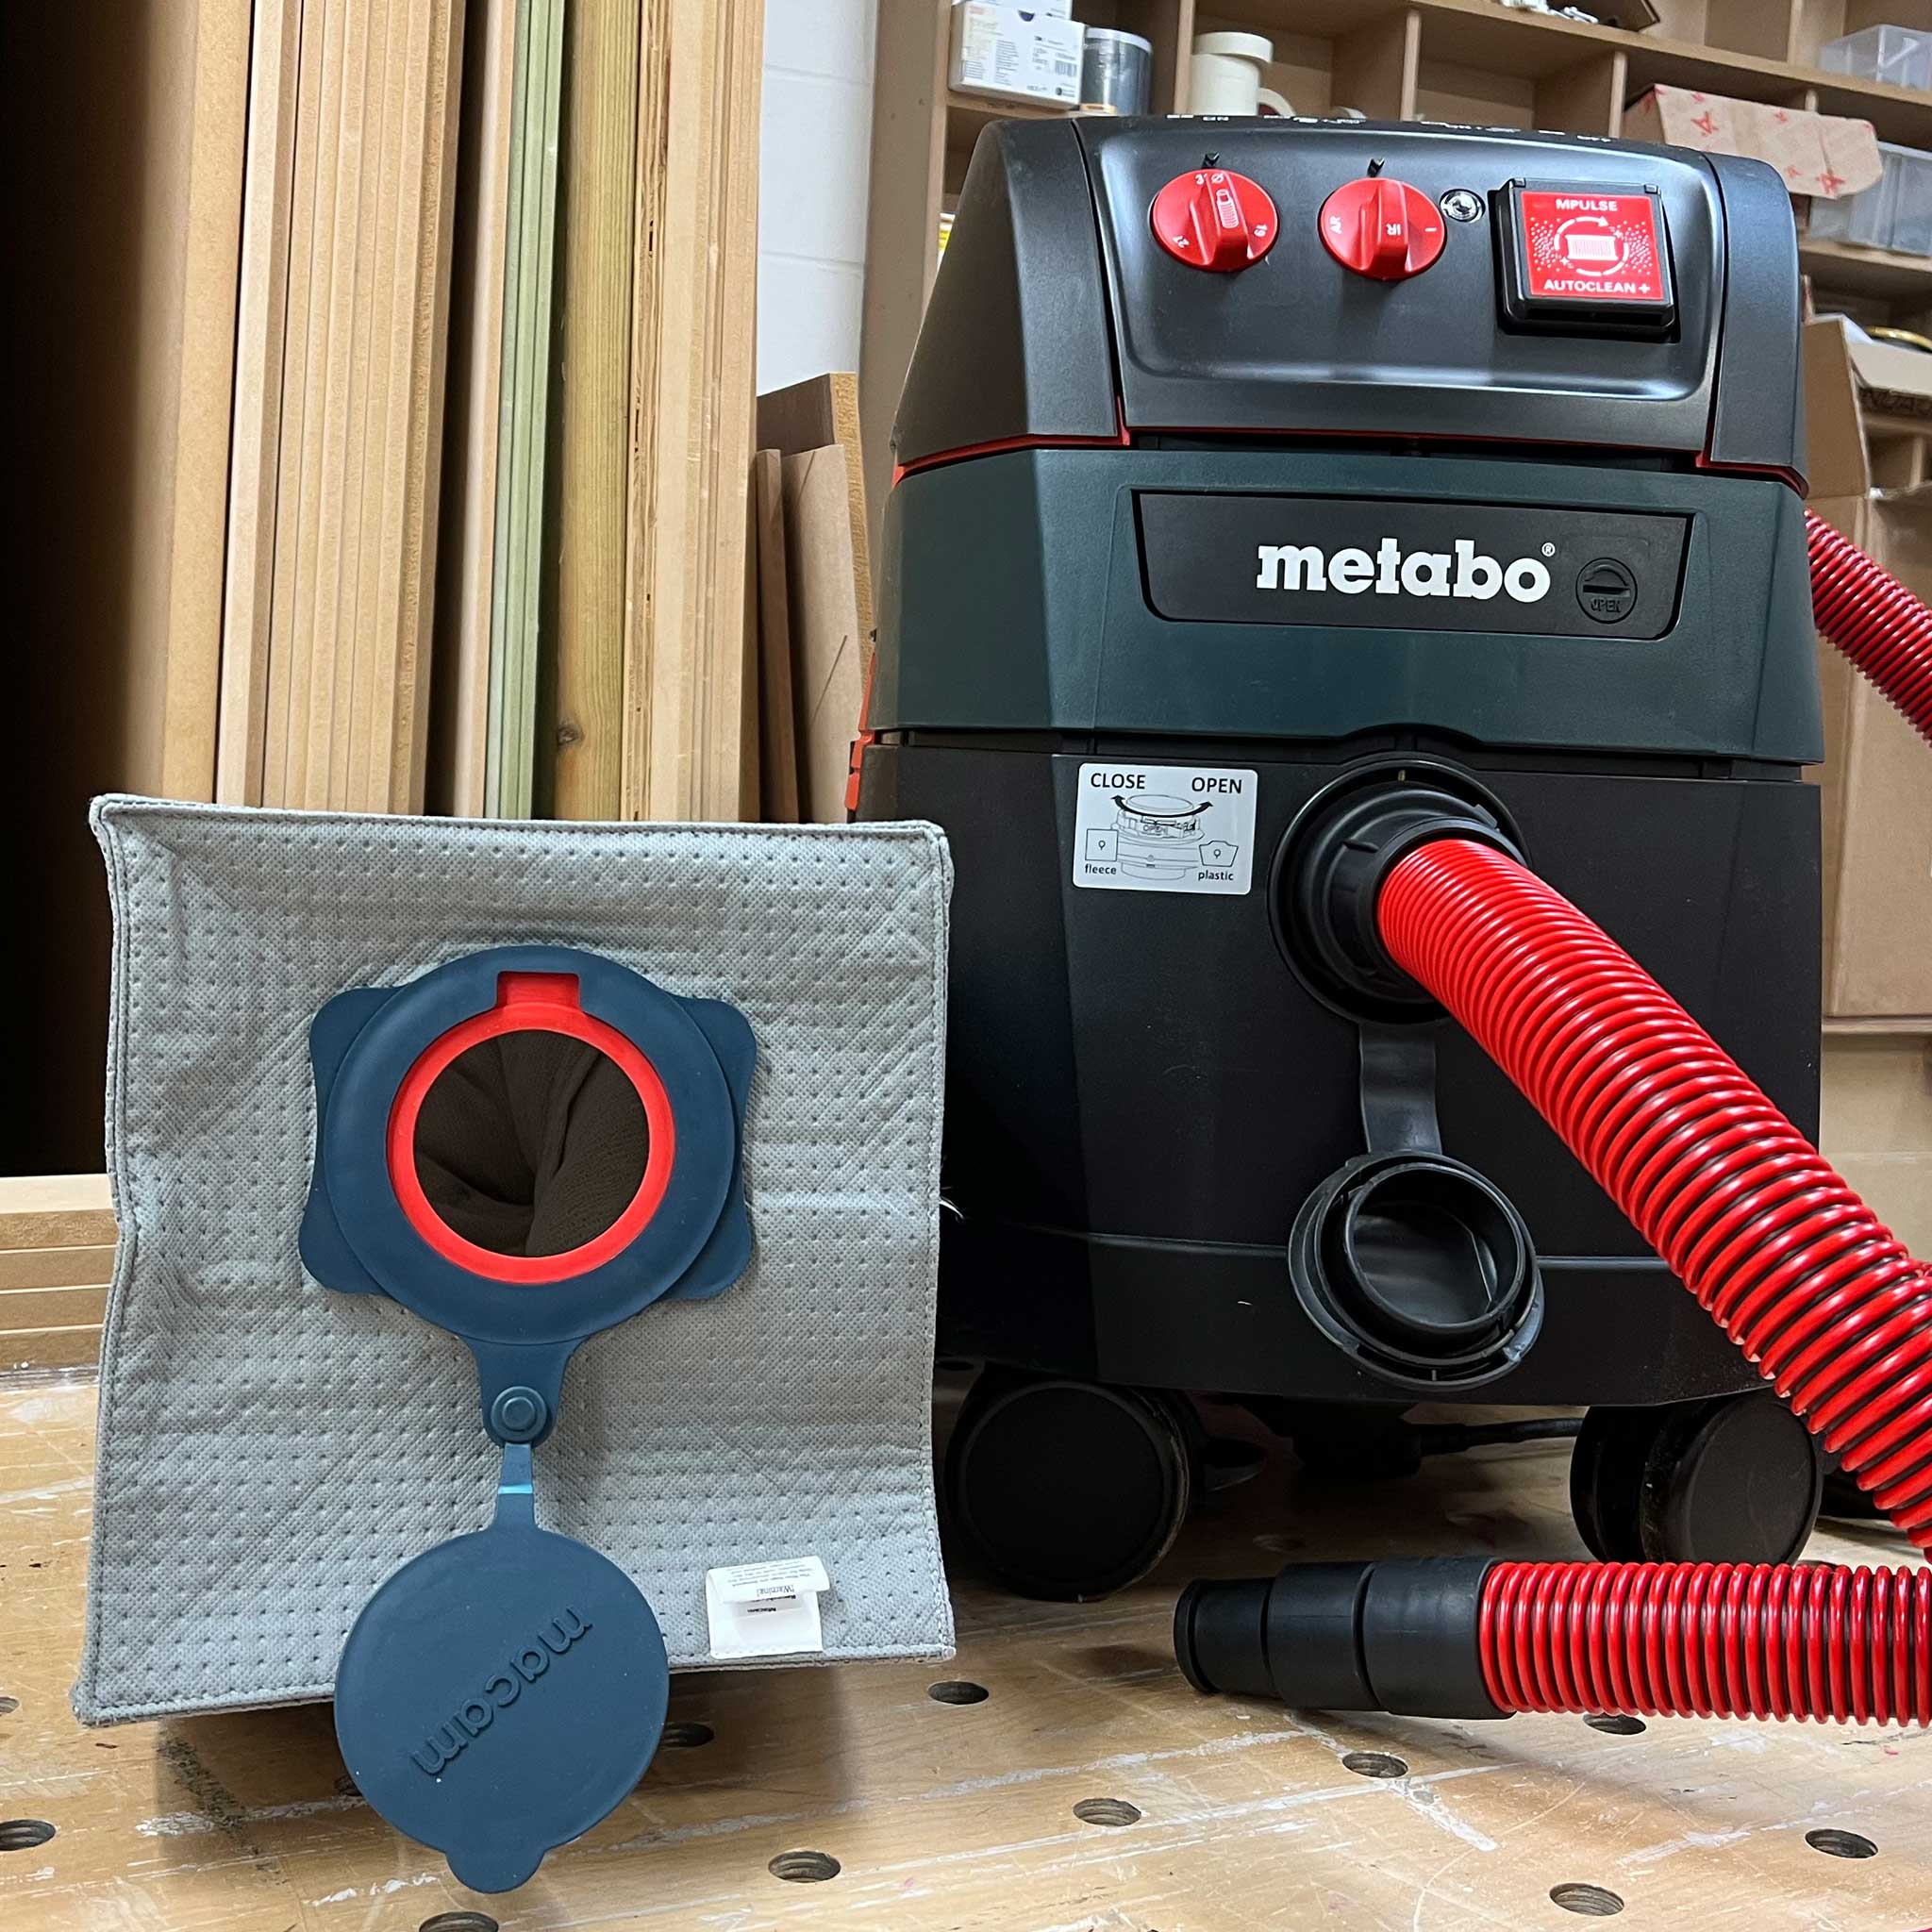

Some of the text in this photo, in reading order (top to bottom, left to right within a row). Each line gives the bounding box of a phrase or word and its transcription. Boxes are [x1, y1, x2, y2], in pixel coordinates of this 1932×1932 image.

[1556, 198, 1618, 211] MPULSE
[1543, 279, 1636, 293] AUTOCLEAN
[1091, 773, 1242, 794] CLOSE OPEN
[1085, 863, 1234, 881] fleece plastic
[410, 1603, 593, 1777] macam
